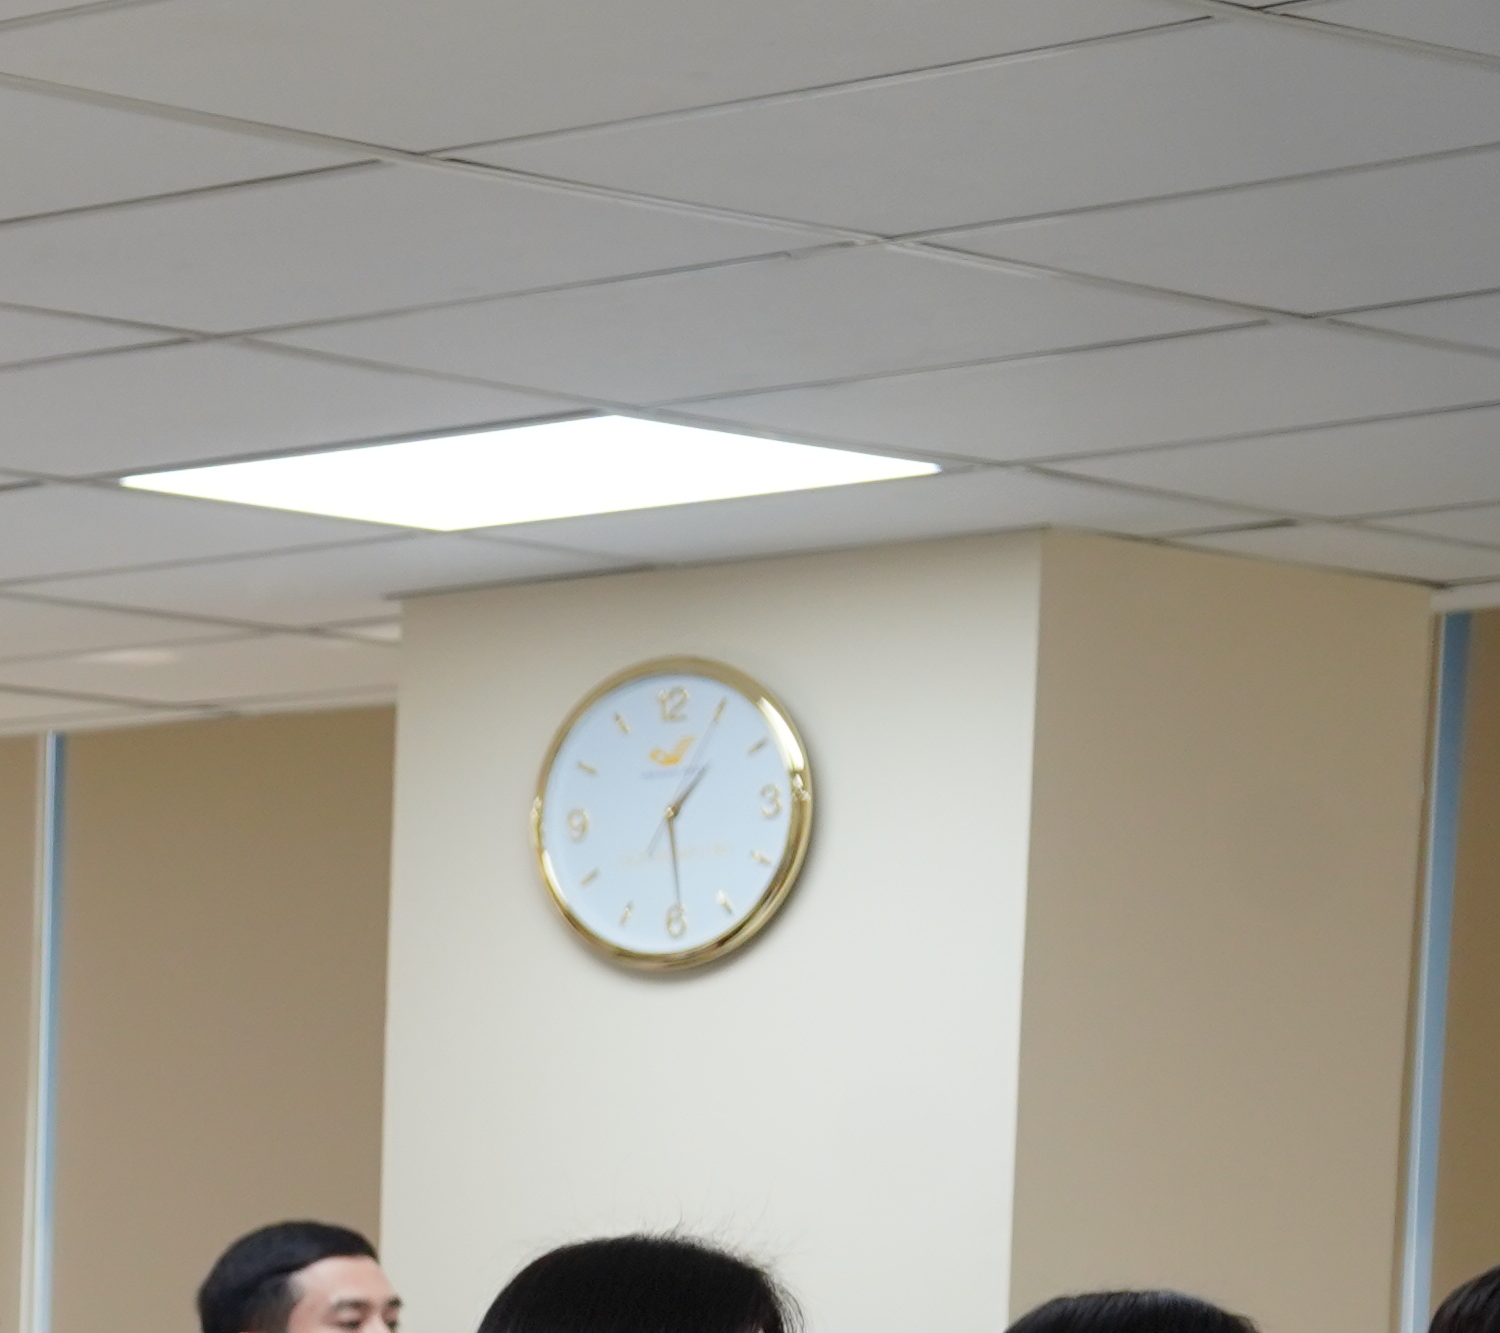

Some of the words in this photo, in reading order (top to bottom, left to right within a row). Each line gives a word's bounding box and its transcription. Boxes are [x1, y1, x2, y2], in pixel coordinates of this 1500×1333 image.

[657, 687, 689, 721] 12
[760, 785, 781, 819] 3
[567, 808, 589, 842] 9
[666, 903, 687, 938] 6
